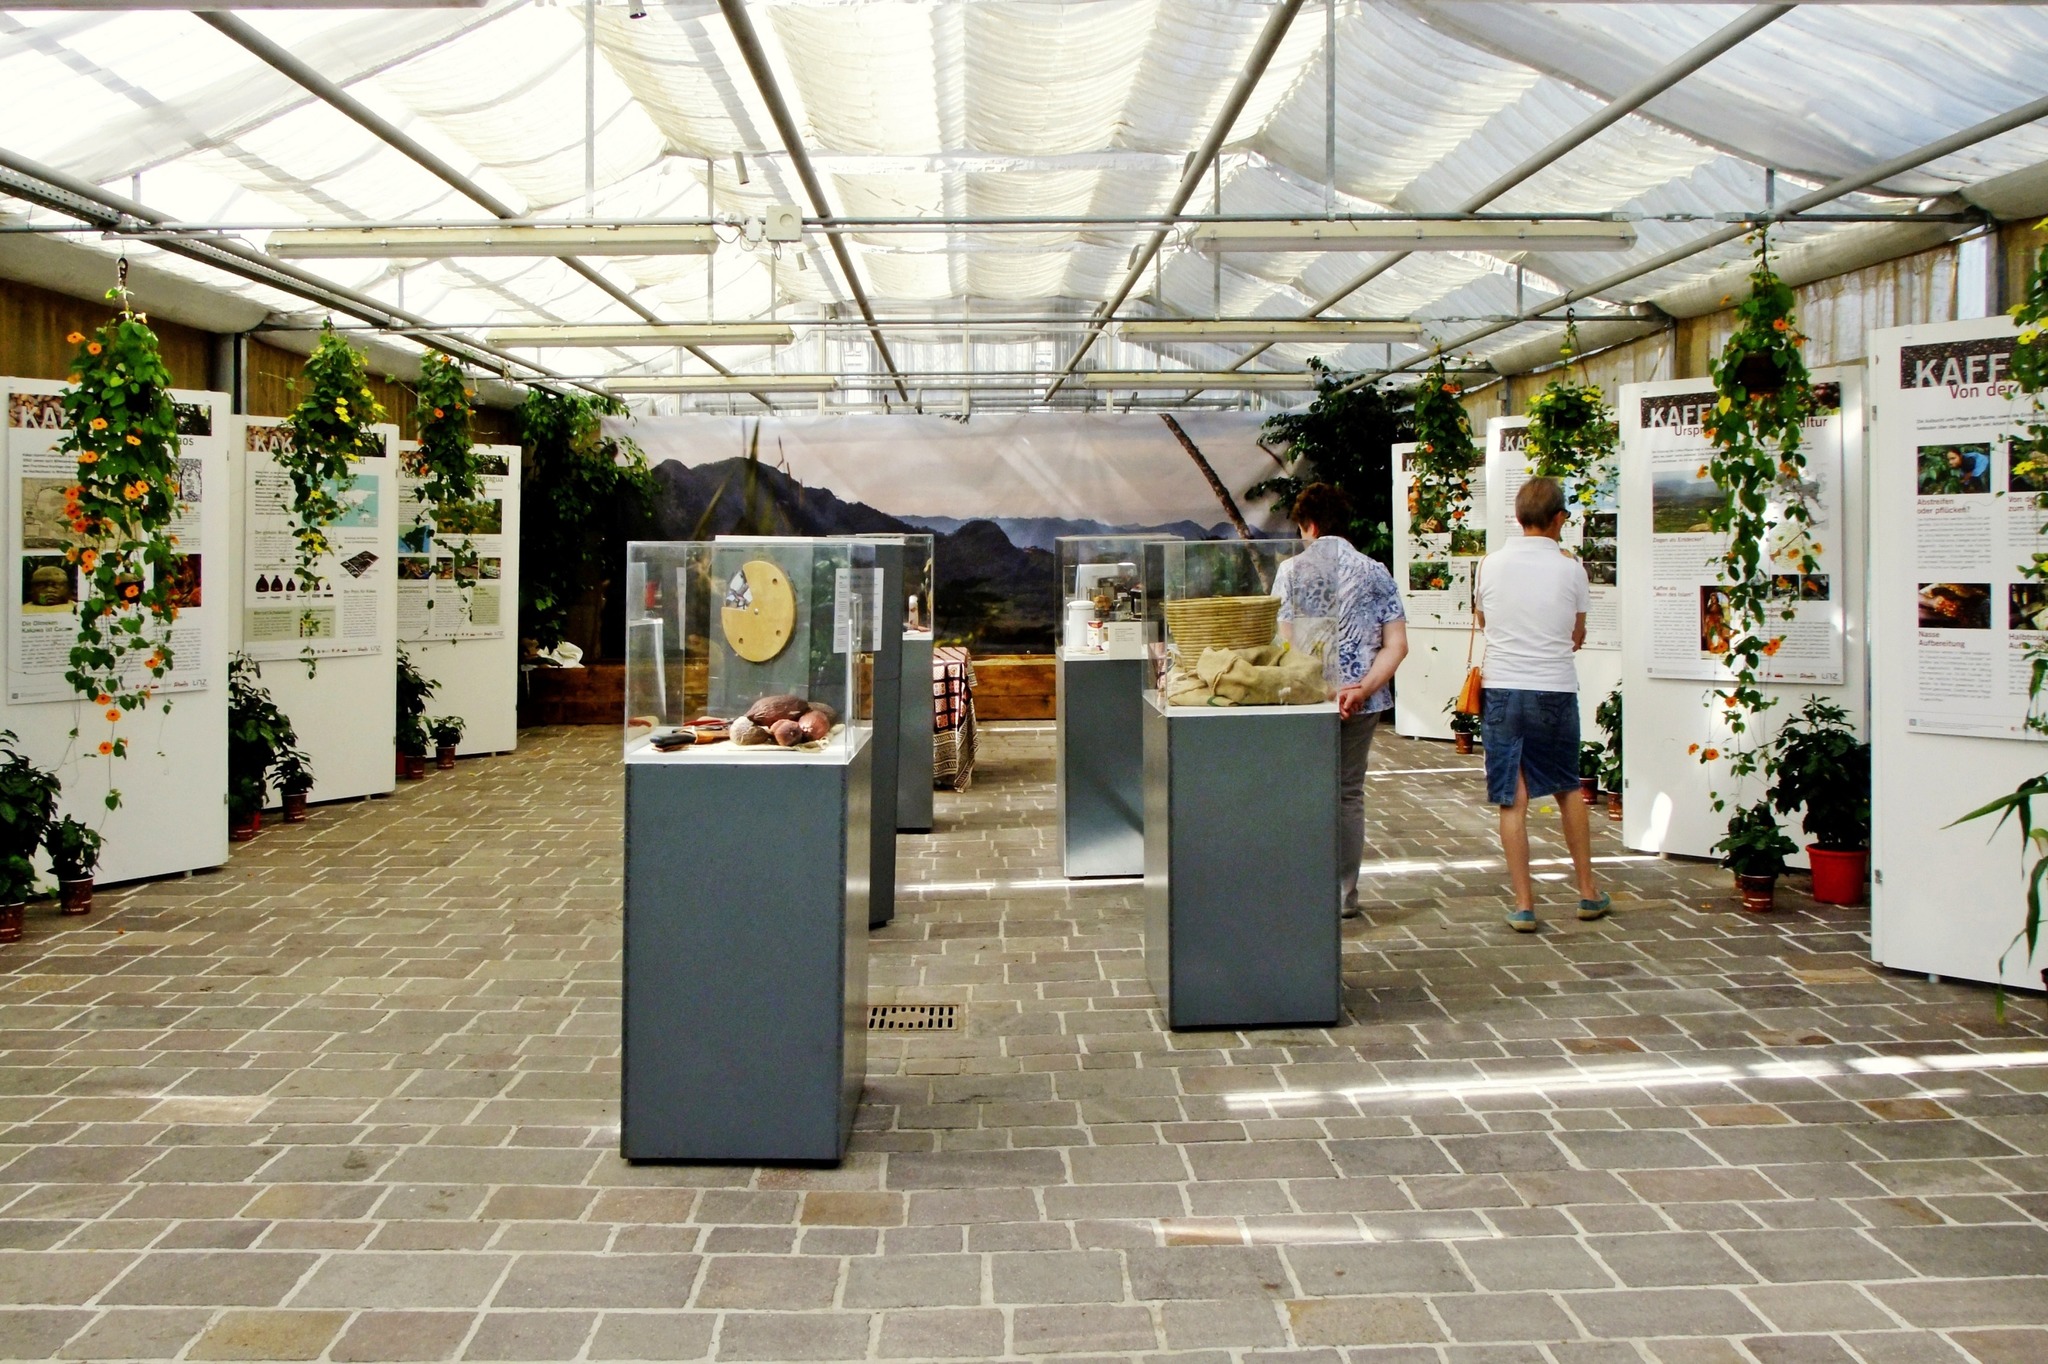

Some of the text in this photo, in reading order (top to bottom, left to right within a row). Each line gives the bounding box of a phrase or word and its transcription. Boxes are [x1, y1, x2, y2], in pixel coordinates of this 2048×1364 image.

[1915, 353, 2010, 388] KAFF
[1949, 381, 2014, 399] Von der
[1650, 403, 1714, 428] KAFF
[1674, 424, 1703, 437] Urspr
[255, 435, 297, 453] KAK
[1917, 498, 1954, 506] Abstreifen
[1919, 640, 1965, 649] Aufbereitung
